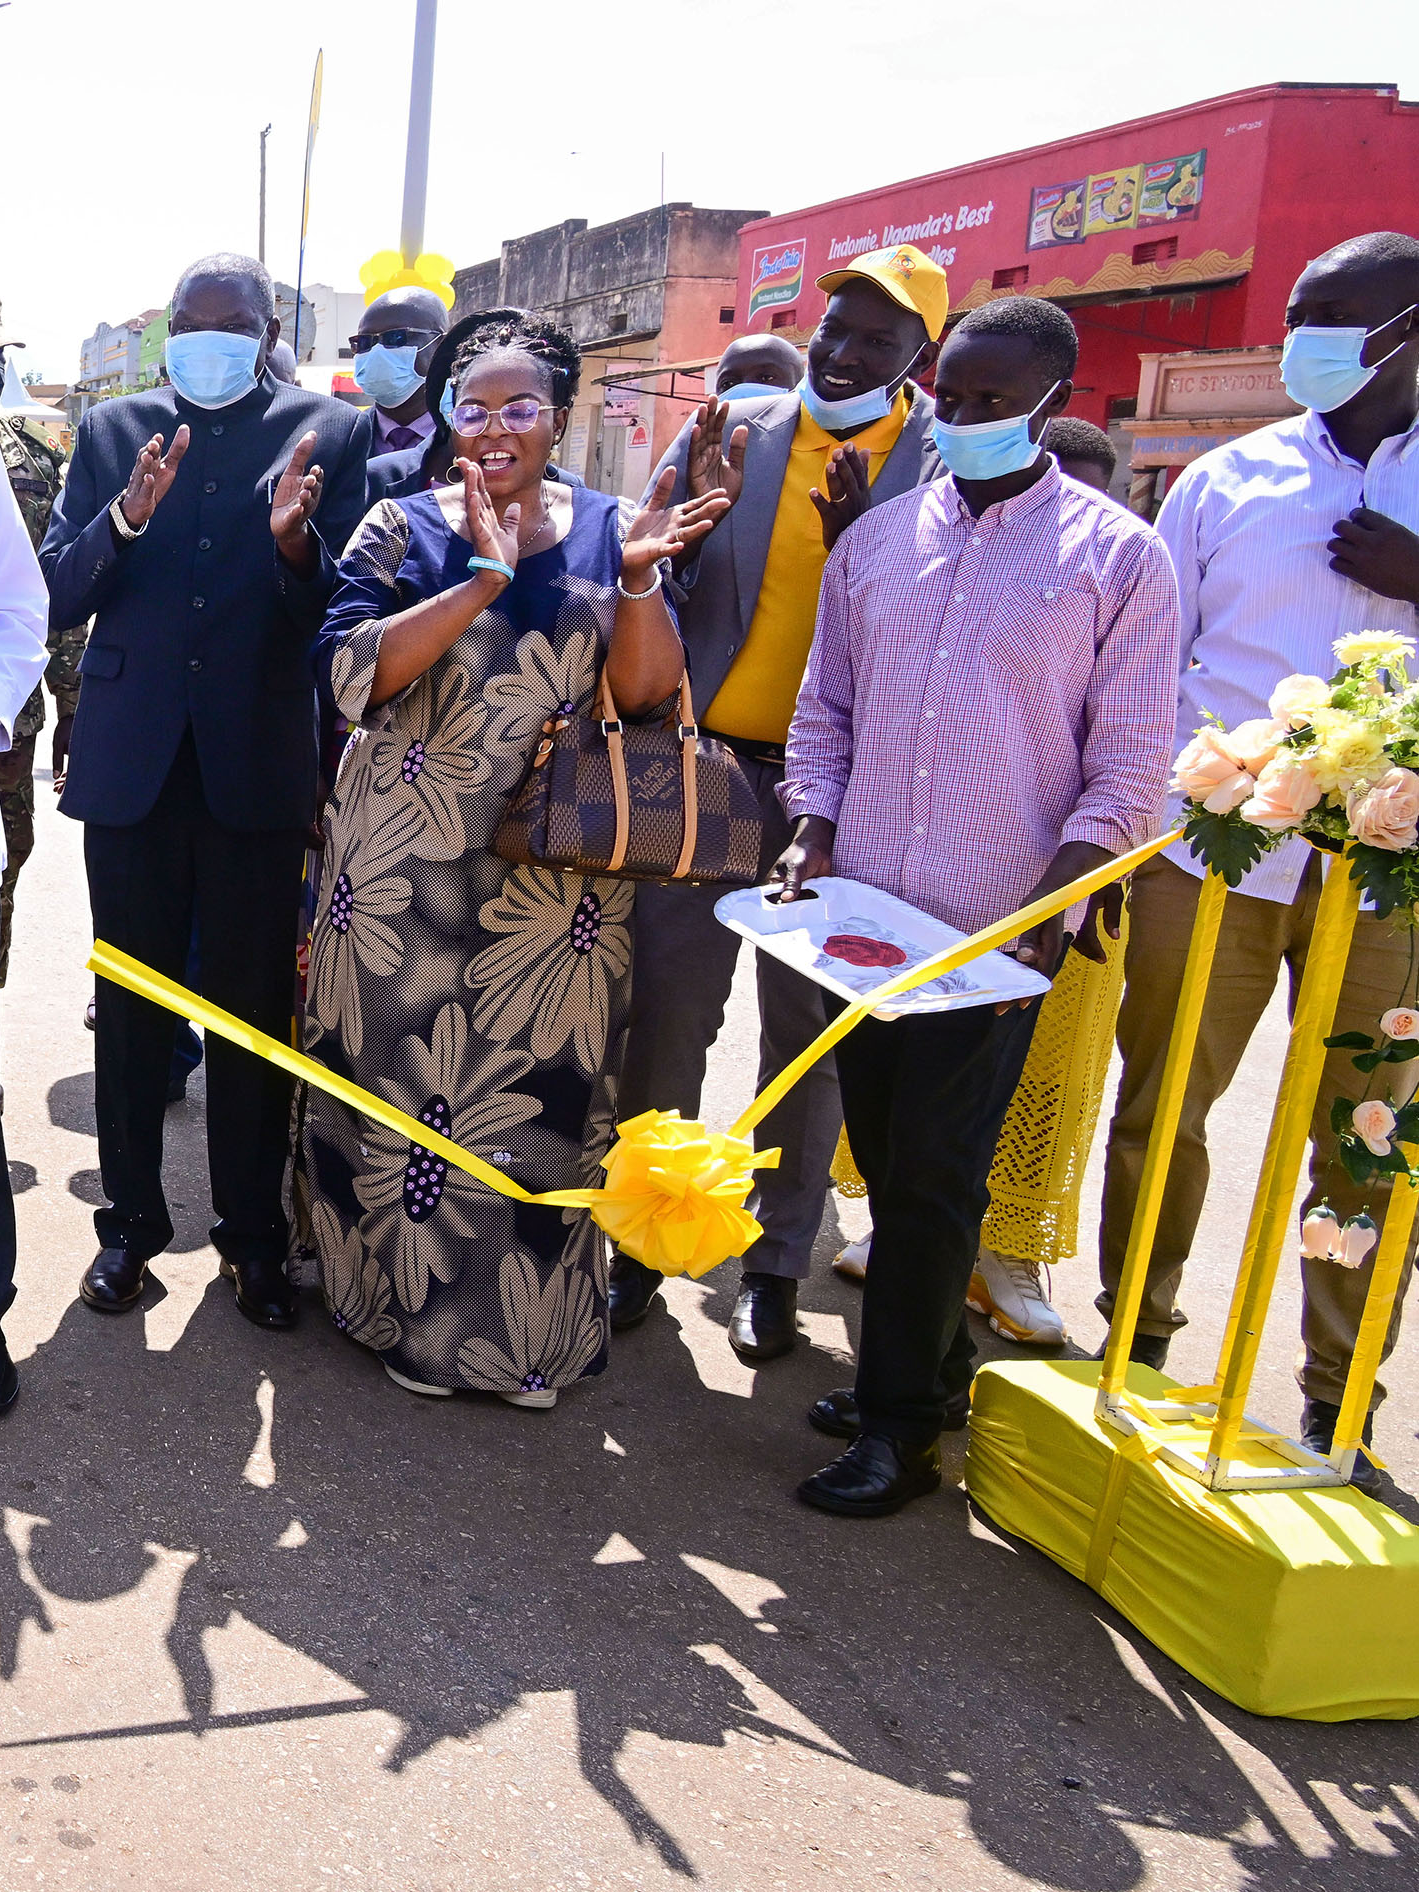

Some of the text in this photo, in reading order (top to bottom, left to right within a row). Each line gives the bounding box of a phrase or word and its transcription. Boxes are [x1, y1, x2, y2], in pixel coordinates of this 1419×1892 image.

[828, 201, 994, 260] Indomie, Uganda's Best
[1199, 374, 1285, 392] STATIONE
[631, 760, 663, 789] Louis
[635, 767, 677, 801] Vuitton
